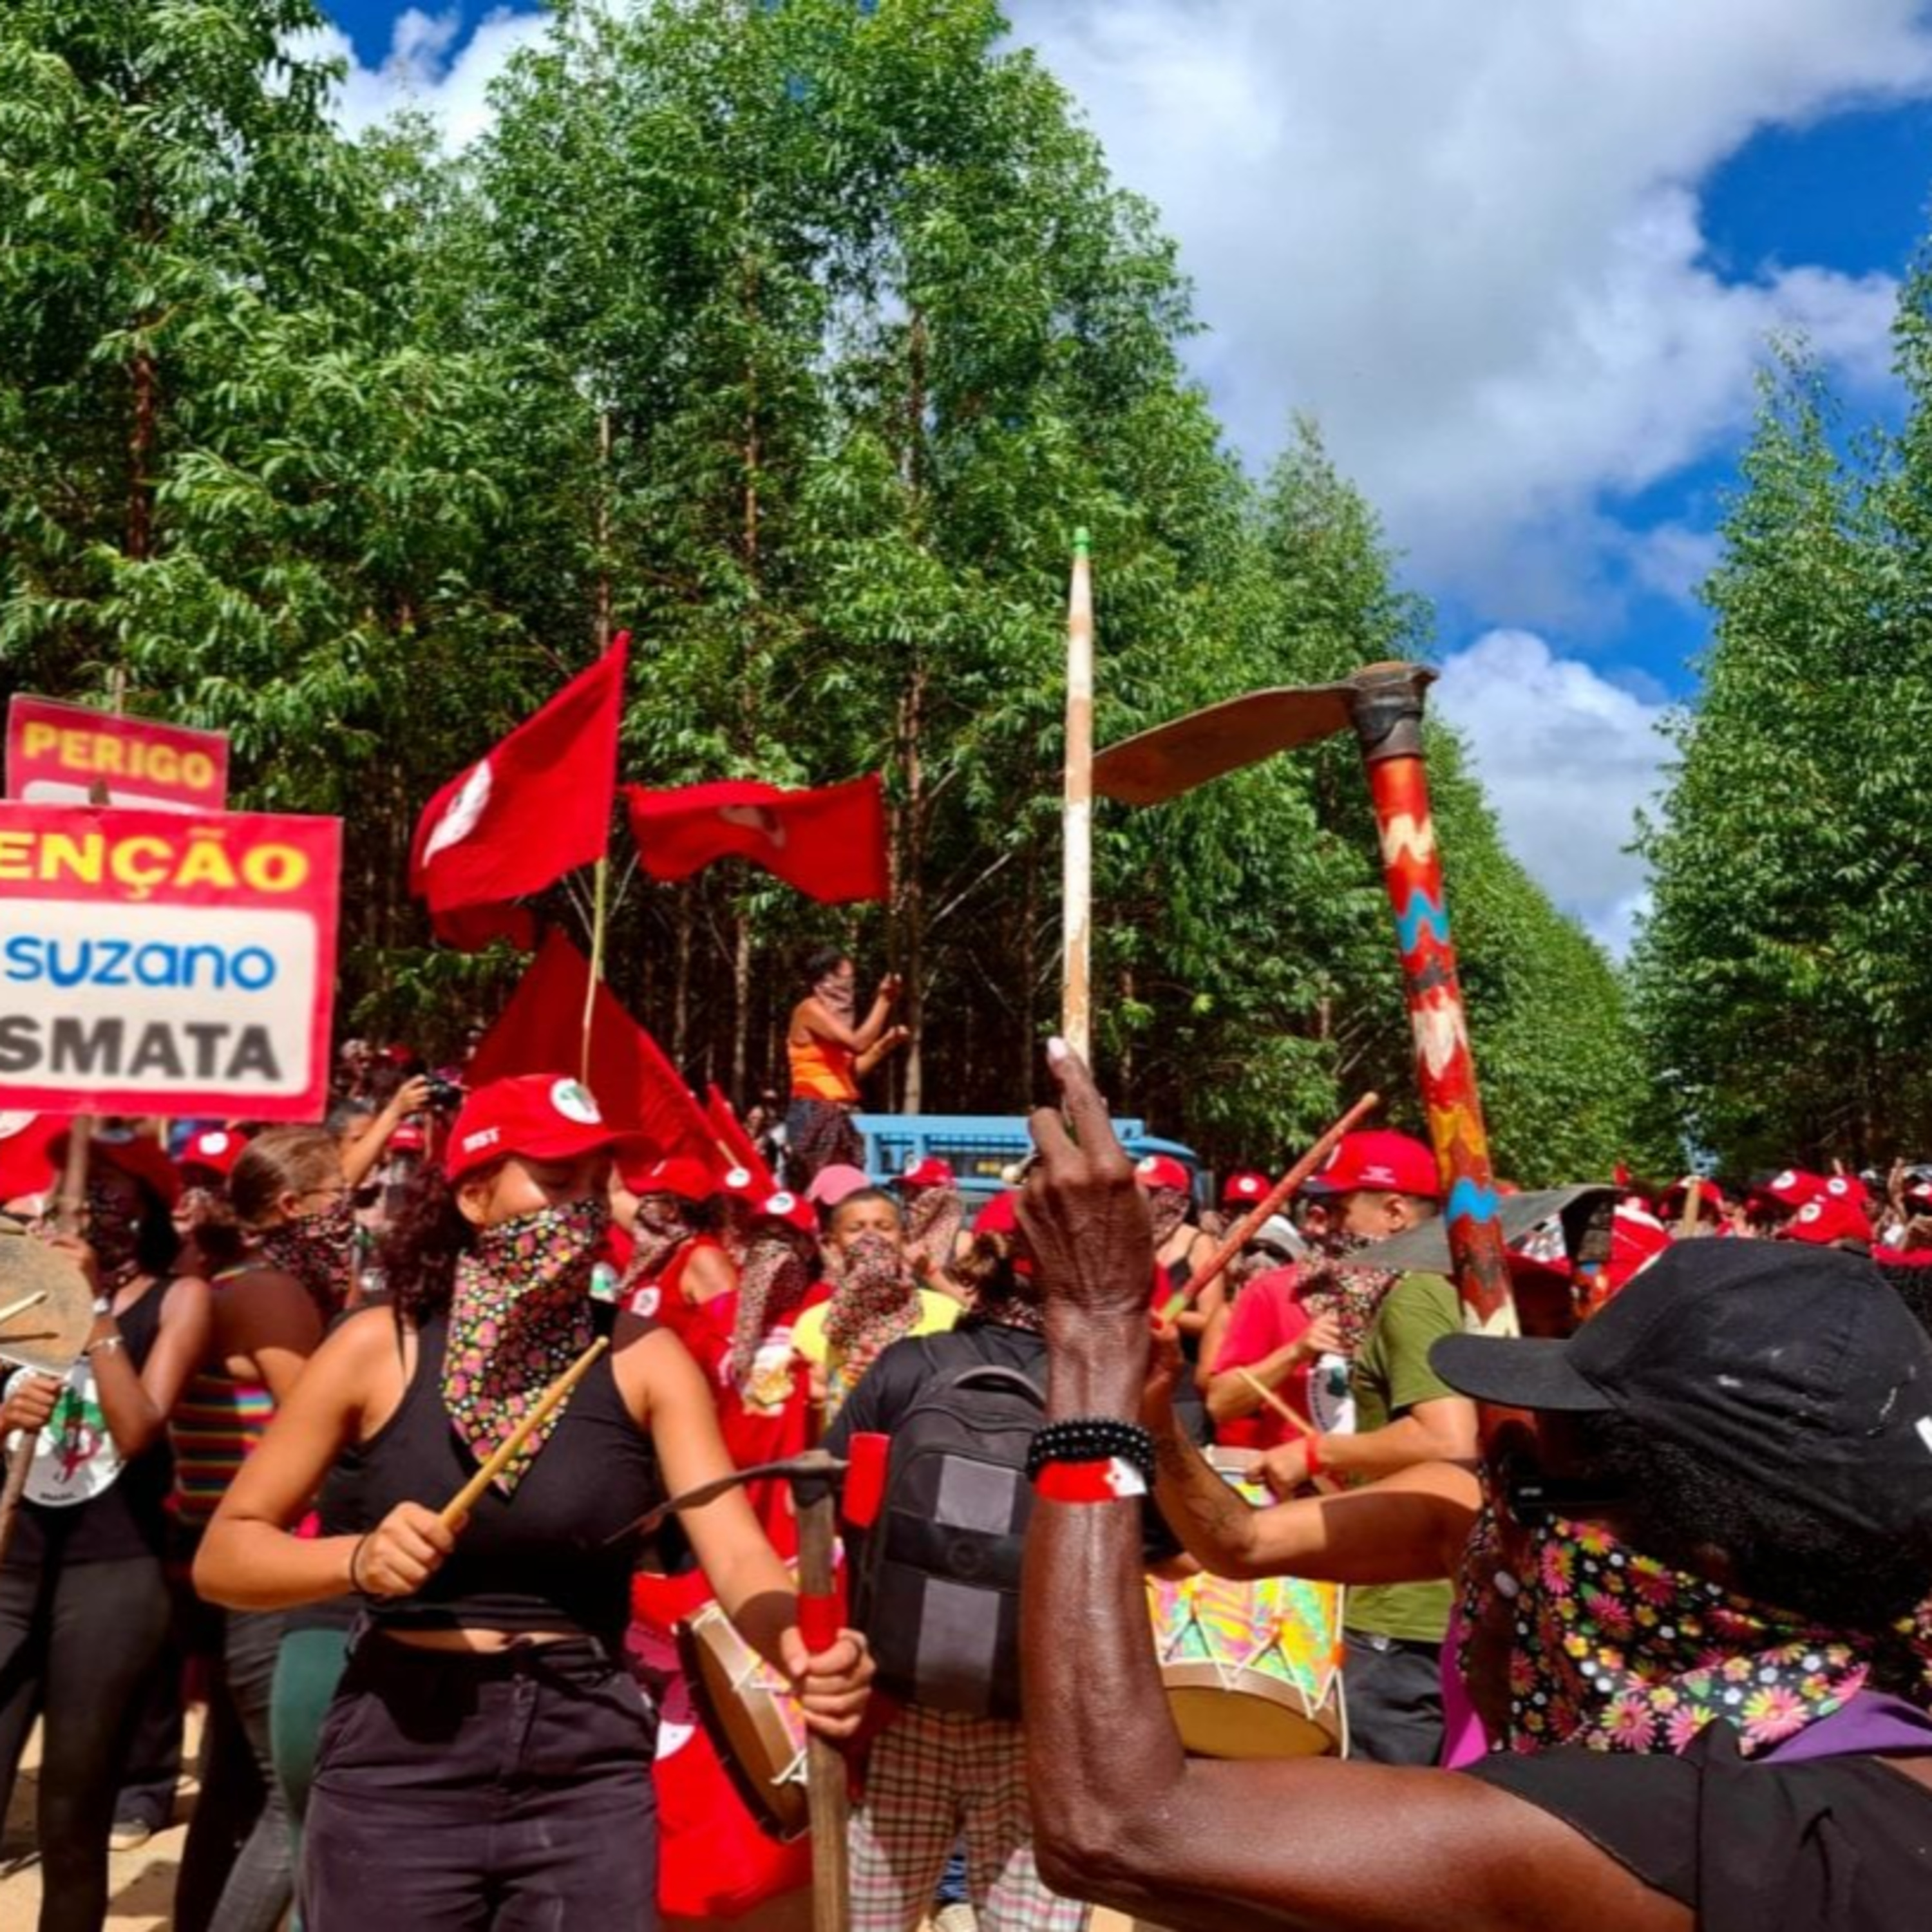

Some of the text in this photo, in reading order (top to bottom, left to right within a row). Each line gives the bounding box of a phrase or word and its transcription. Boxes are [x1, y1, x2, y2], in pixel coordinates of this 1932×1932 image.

[23, 723, 214, 790] PERIGO
[5, 936, 276, 990] suzano
[0, 1016, 281, 1081] SMATA
